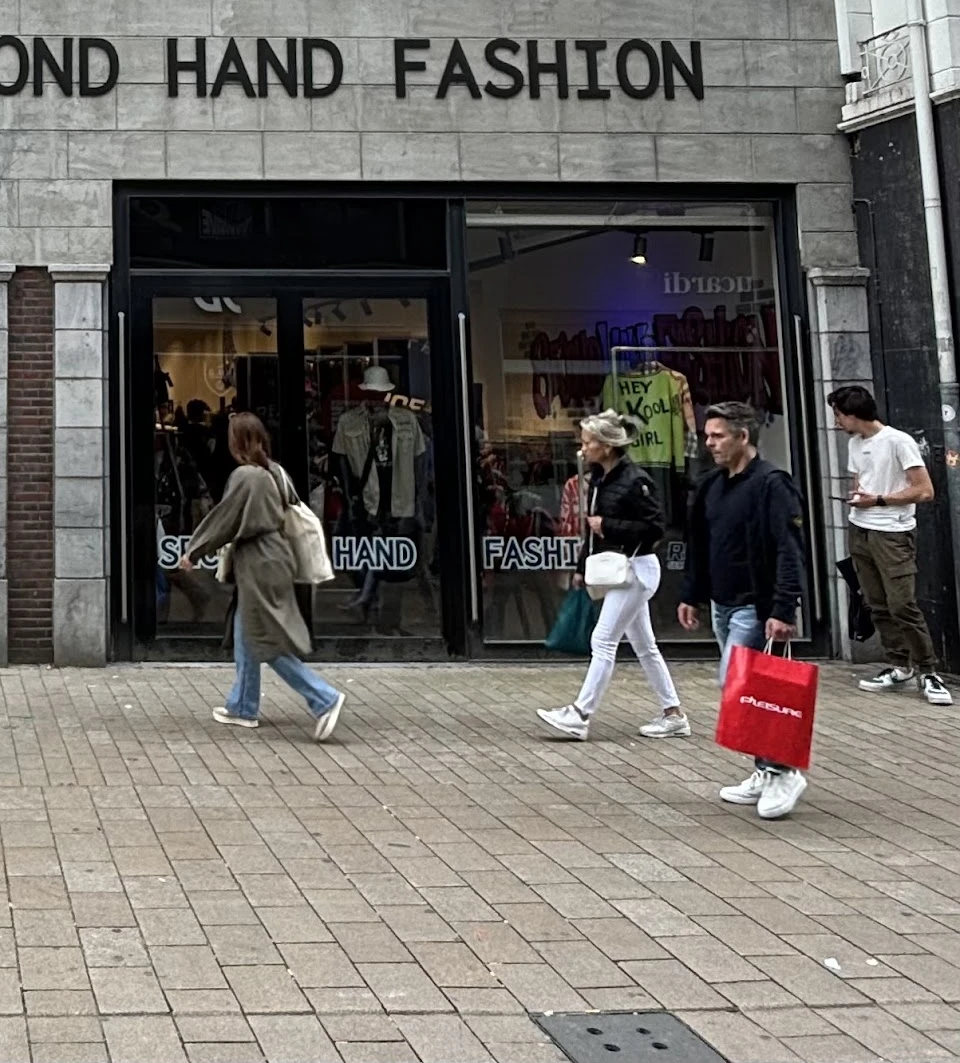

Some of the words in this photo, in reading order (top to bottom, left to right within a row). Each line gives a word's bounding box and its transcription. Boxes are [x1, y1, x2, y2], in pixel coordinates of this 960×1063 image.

[166, 37, 343, 99] HAND
[393, 38, 705, 101] FASHION
[619, 380, 652, 395] HEY
[626, 397, 669, 425] KOOL
[332, 536, 417, 570] HAND
[483, 536, 583, 569] FASHI
